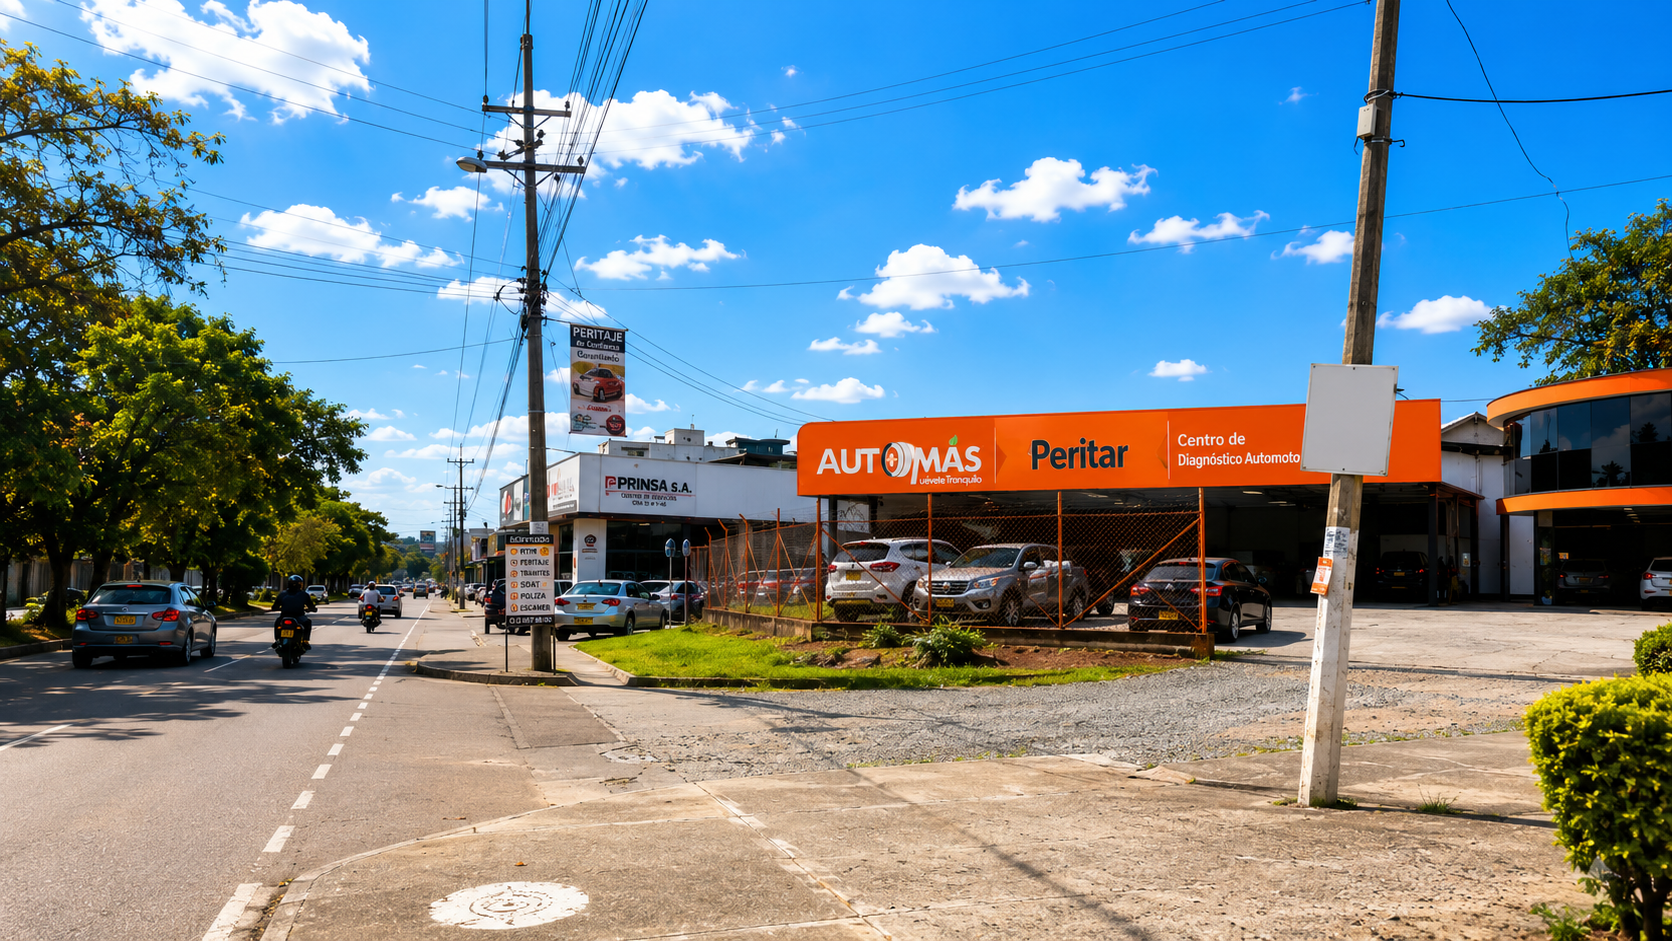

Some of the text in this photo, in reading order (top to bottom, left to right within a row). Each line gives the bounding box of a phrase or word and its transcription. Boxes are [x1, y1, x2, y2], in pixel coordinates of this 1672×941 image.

[573, 327, 623, 342] PERITAJE
[1178, 432, 1246, 446] Centro de
[1031, 437, 1129, 470] Peritar
[1178, 451, 1301, 469] Diagnóstico Automoto
[617, 477, 668, 492] PRINSA
[671, 482, 692, 493] S.A.
